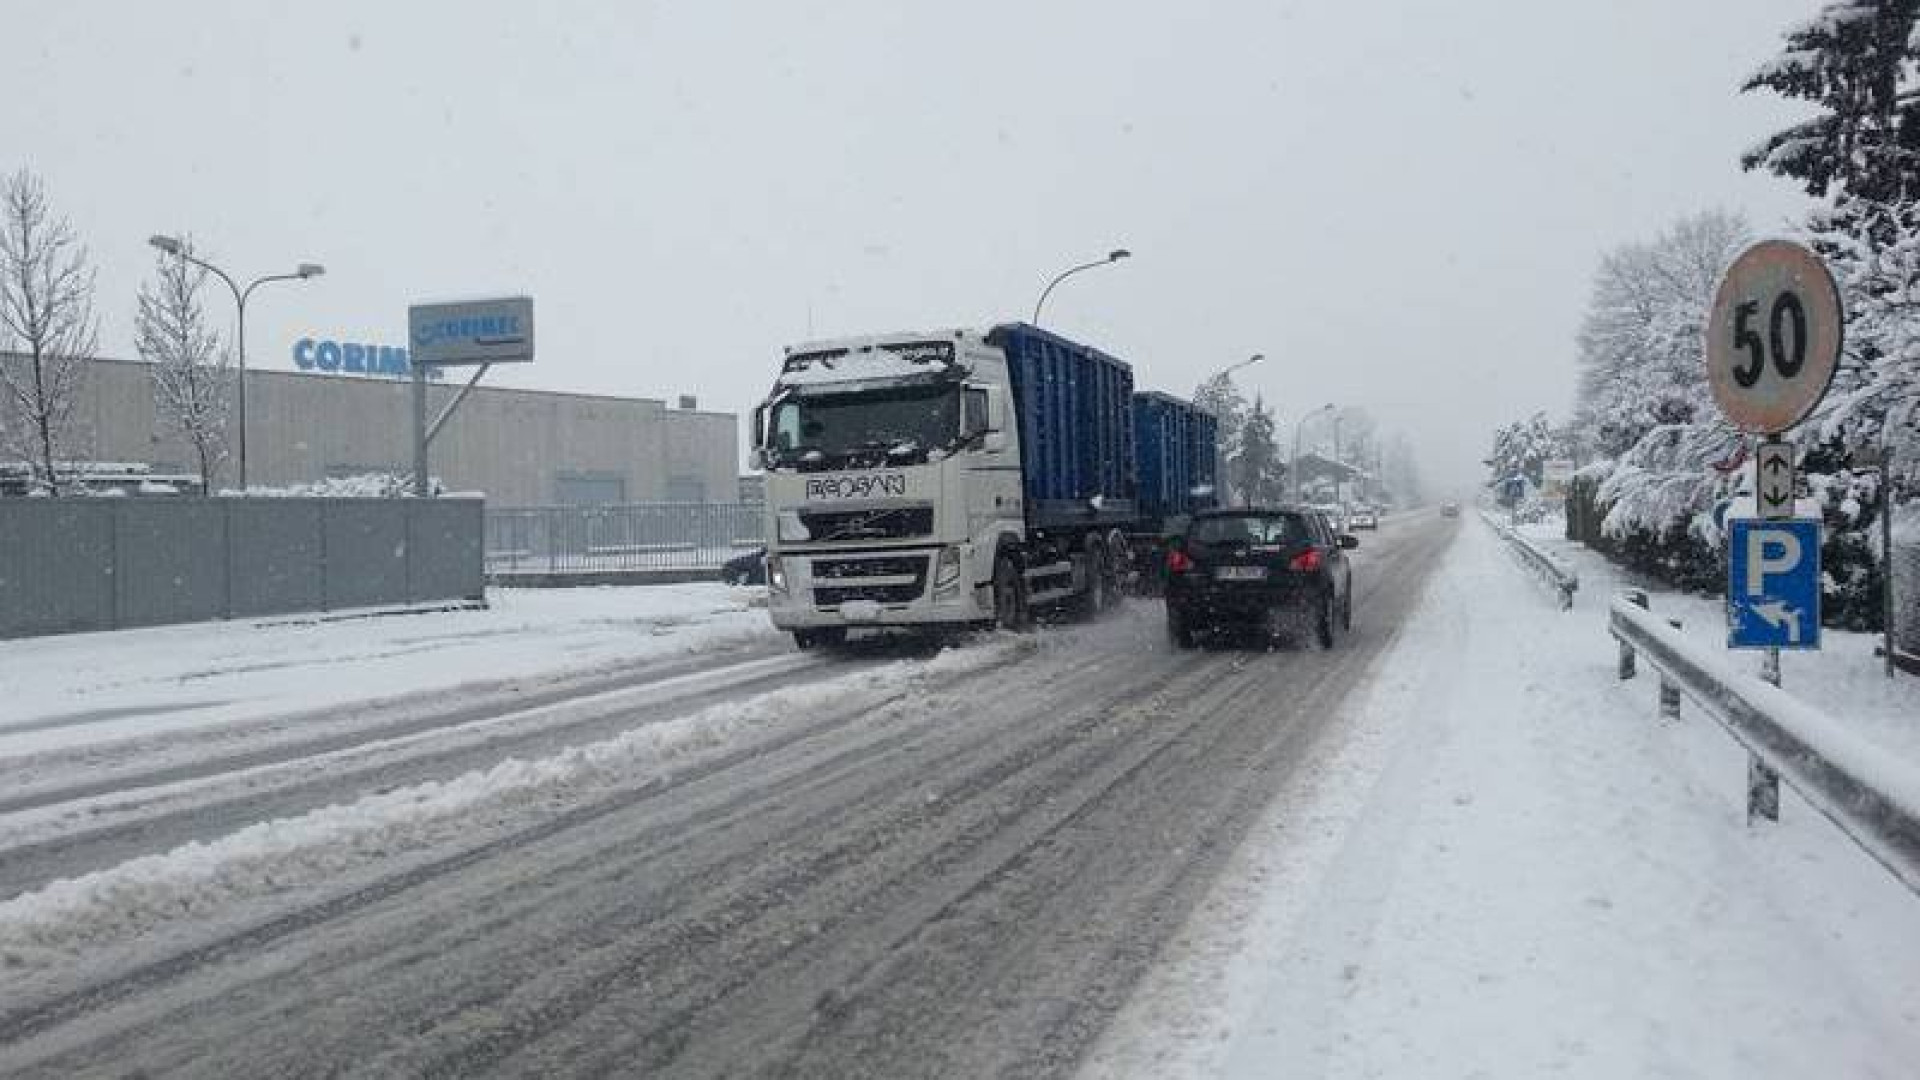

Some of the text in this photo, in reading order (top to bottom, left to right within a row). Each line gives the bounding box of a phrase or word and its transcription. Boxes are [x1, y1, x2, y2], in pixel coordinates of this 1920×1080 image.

[294, 338, 443, 379] CORIM
[1732, 290, 1806, 389] 50
[1747, 530, 1801, 596] P
